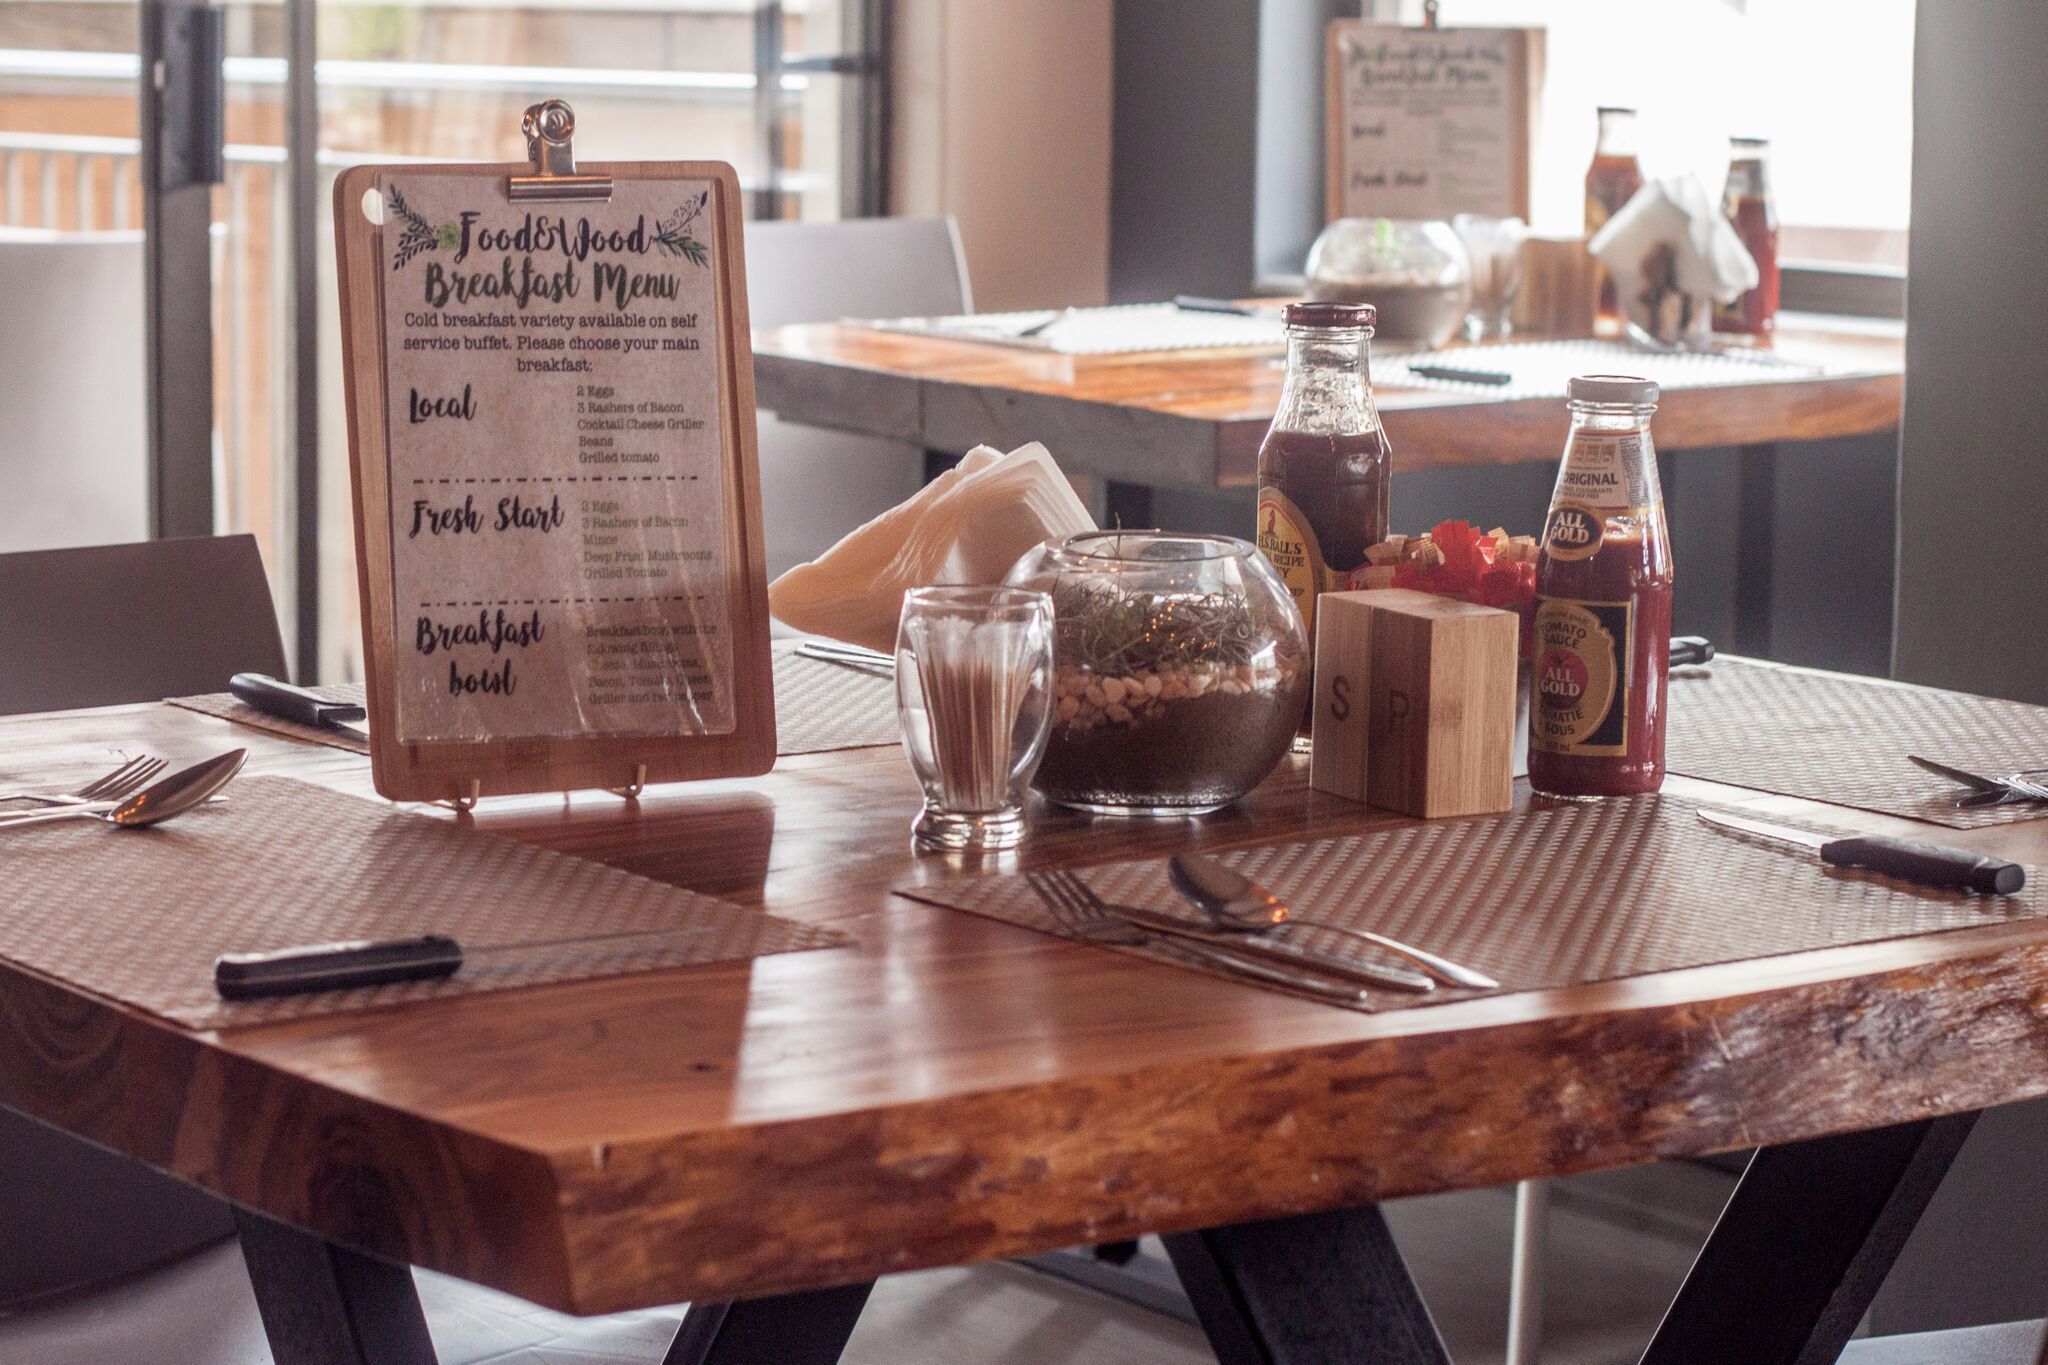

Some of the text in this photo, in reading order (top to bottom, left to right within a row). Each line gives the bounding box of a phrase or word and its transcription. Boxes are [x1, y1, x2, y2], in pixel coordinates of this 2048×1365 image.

[424, 256, 681, 311] Breakfast Menu
[404, 312, 698, 331] Cold breakfast variety available on self
[403, 335, 700, 353] service buffet. Please choose your main
[516, 357, 593, 372] breakfast:
[576, 385, 615, 399] 2 Eggs
[410, 383, 477, 424] Local
[588, 402, 635, 414] Rashers
[637, 402, 649, 414] of
[650, 402, 685, 414] Bacon
[577, 418, 704, 430] Cocktail Cheese Griller
[578, 435, 614, 447] Beans
[579, 452, 660, 464] Grilled tomato
[409, 494, 565, 539] Fresh Start
[641, 515, 653, 528] of
[1555, 511, 1586, 528] ALL
[1550, 526, 1590, 543] GOLD
[416, 608, 546, 655] Breakfast
[1544, 634, 1581, 649] SAUCE
[449, 657, 517, 697] bowl
[1545, 667, 1575, 683] ALL
[1540, 680, 1581, 696] GOLD
[1331, 676, 1350, 721] S
[1389, 688, 1410, 735] P
[1545, 721, 1576, 735] SOUS
